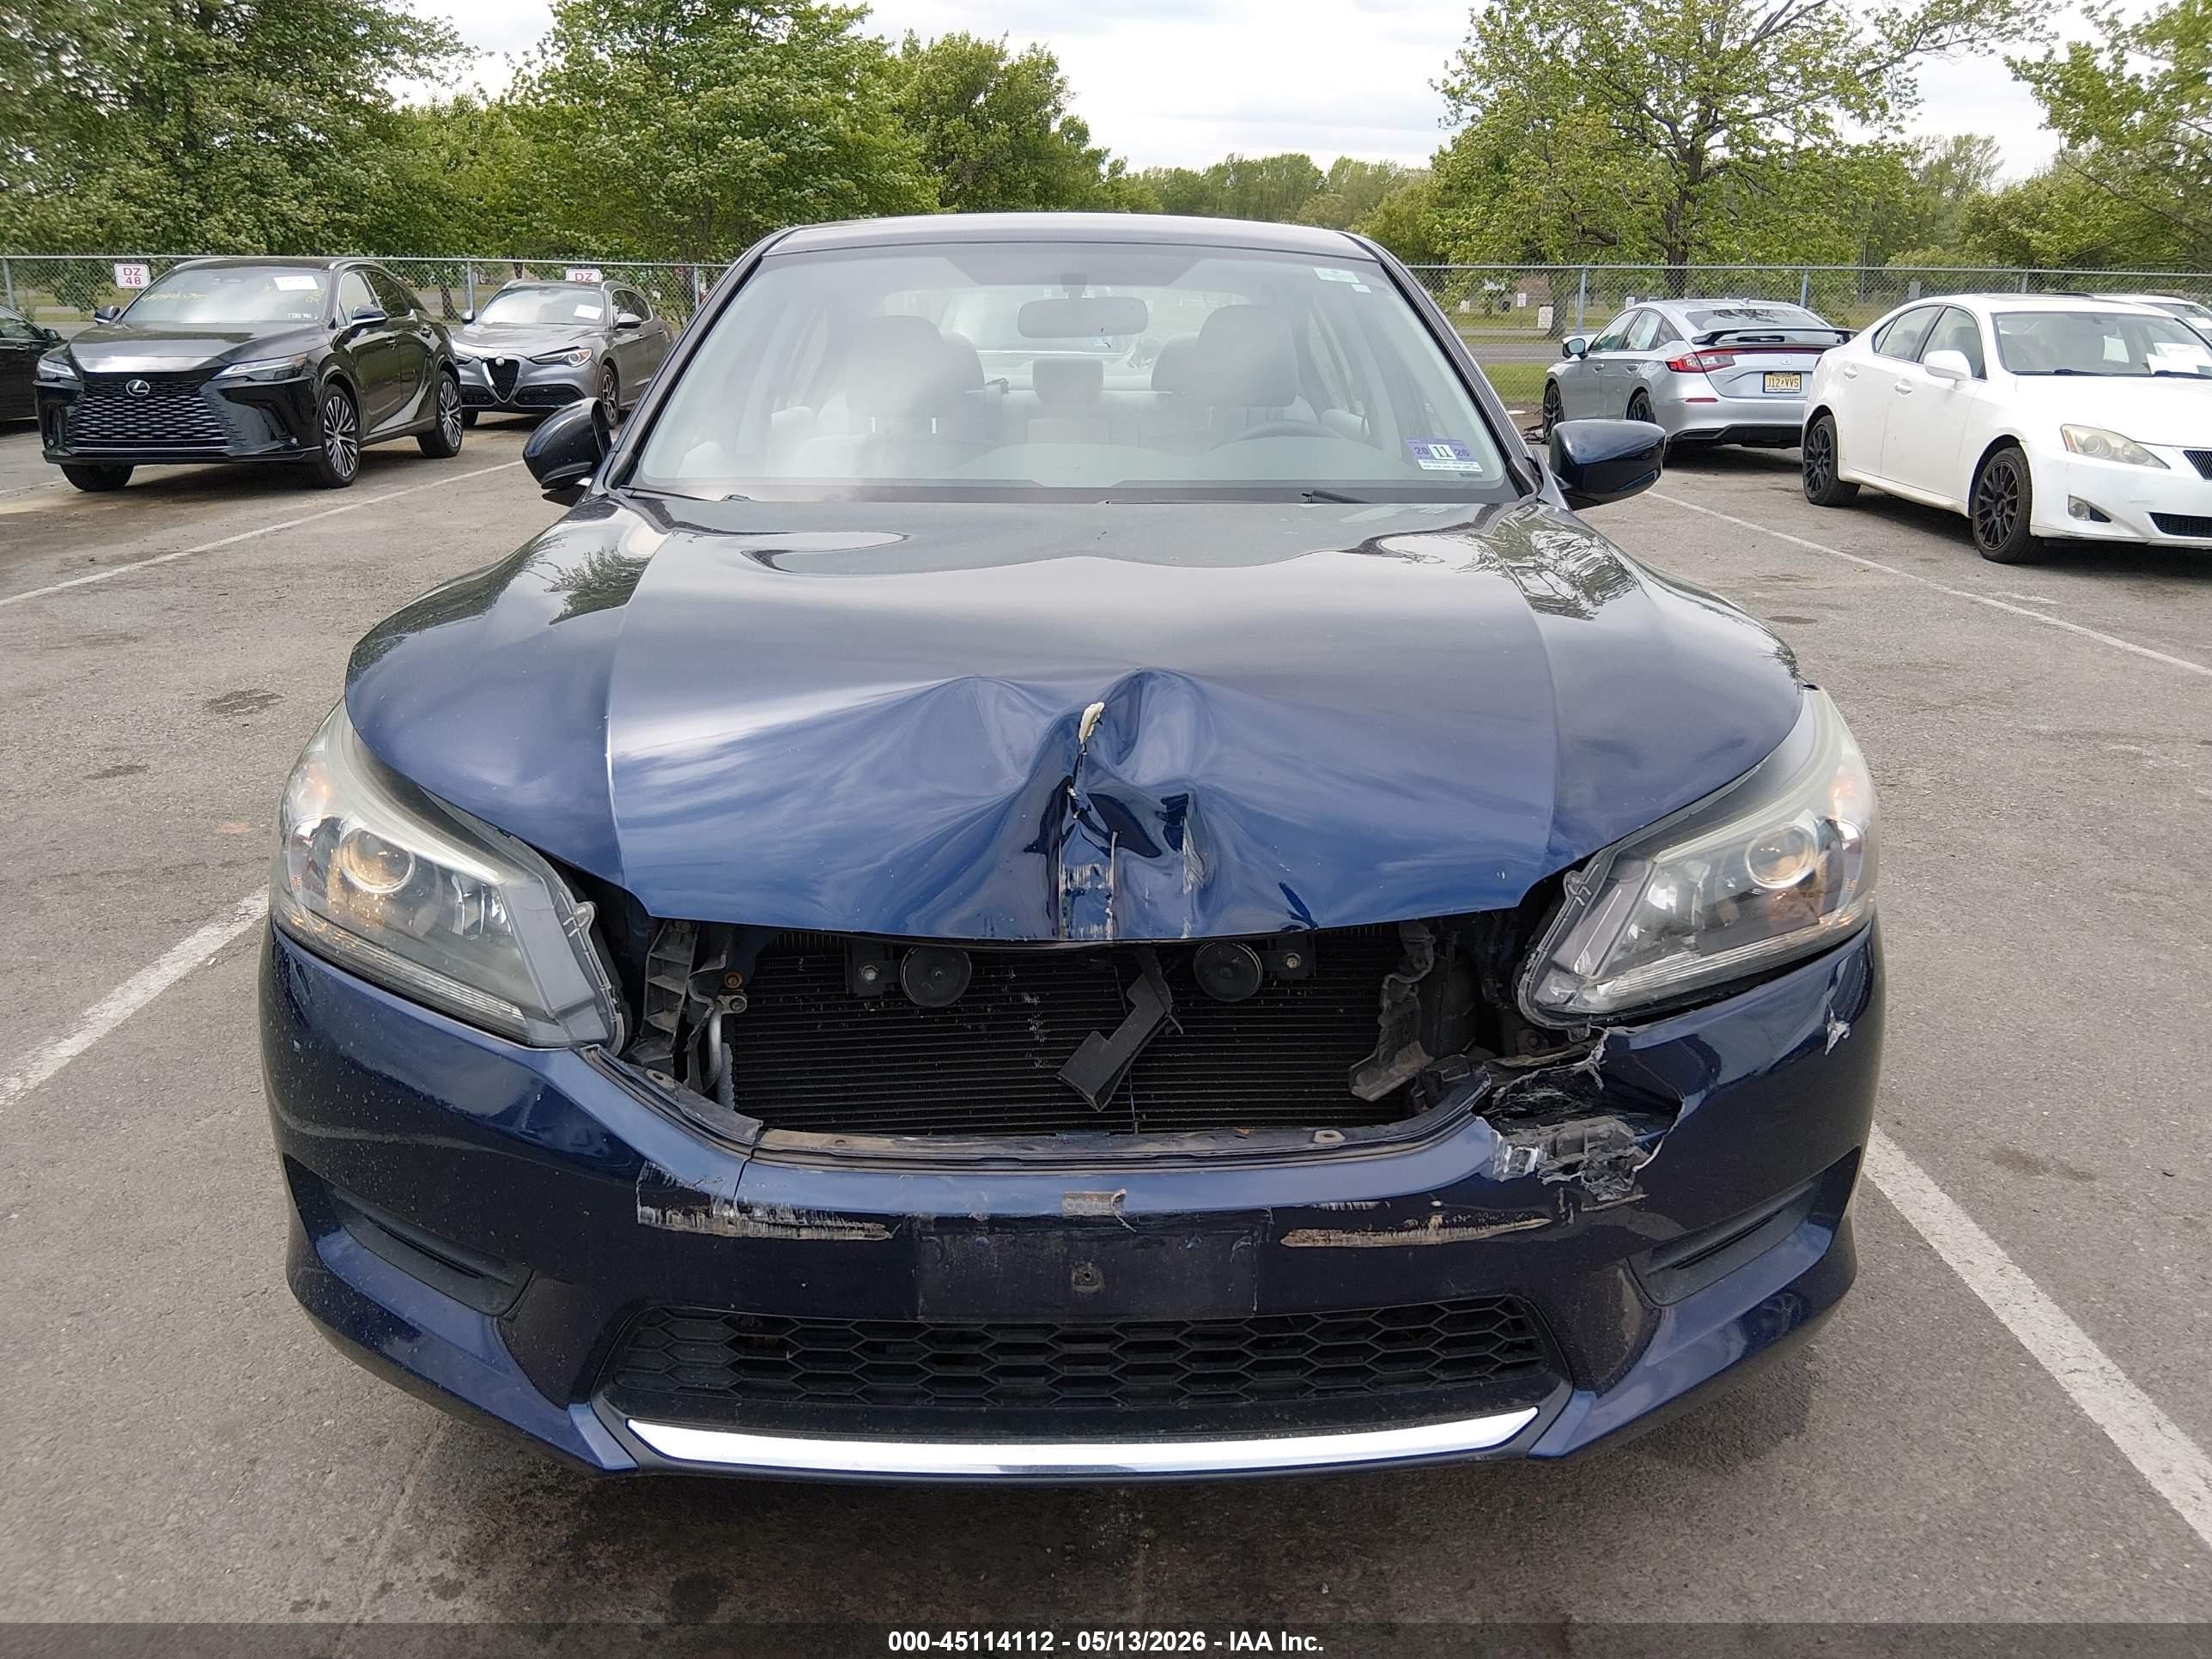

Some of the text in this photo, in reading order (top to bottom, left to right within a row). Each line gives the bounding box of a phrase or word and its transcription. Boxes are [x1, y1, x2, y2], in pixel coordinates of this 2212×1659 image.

[123, 267, 142, 276] DZ
[125, 276, 142, 285] 48
[574, 272, 593, 282] DZ
[1414, 447, 1430, 455] 20
[1432, 446, 1454, 458] 11
